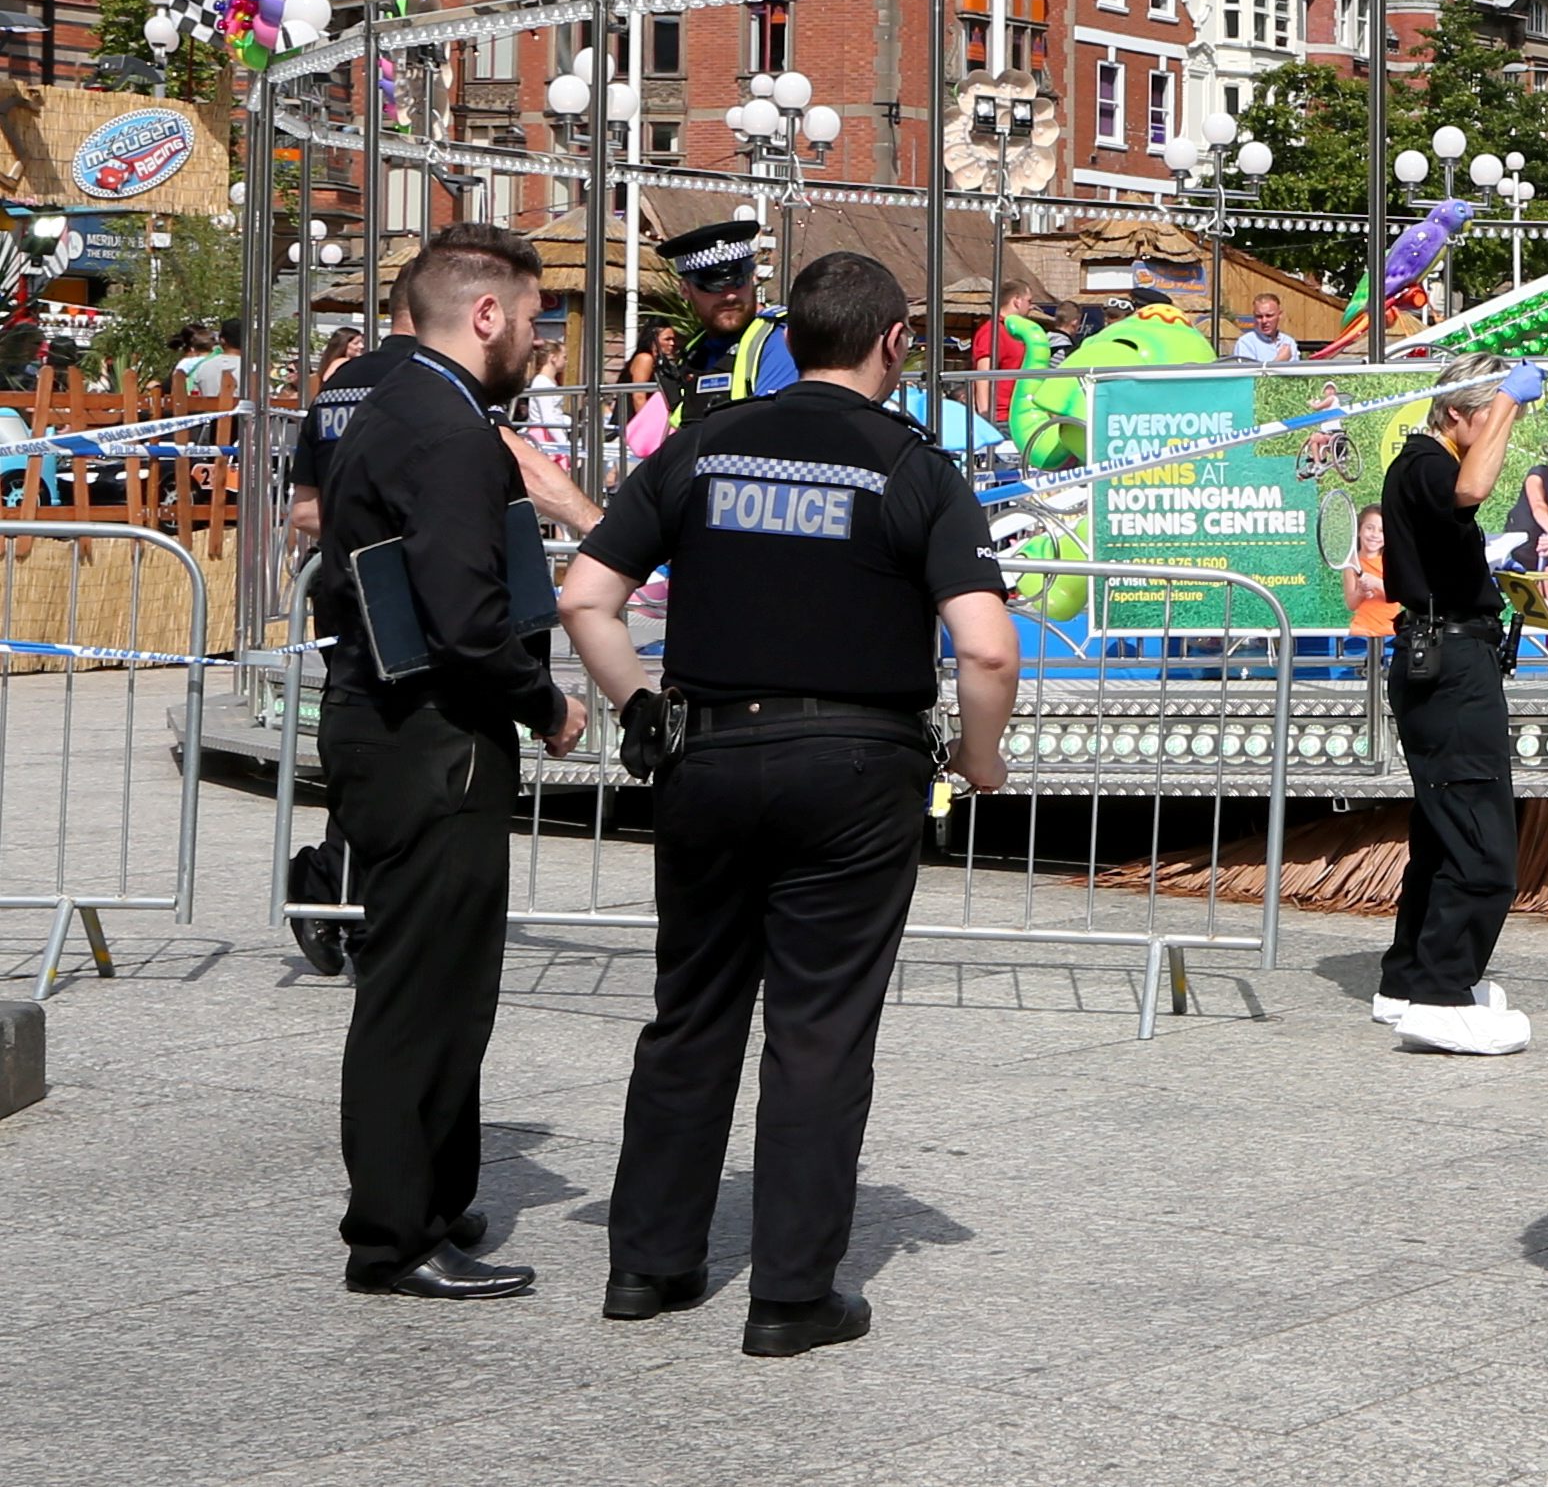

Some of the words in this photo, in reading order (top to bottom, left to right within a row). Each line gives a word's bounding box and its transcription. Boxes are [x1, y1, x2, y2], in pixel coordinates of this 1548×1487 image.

[321, 406, 355, 437] PO
[1108, 412, 1233, 437] EVERYONE
[1108, 439, 1160, 459] CAN
[1201, 462, 1229, 484] AT
[712, 481, 846, 535] POLICE
[1108, 486, 1282, 511] NOTTINGHAM
[1108, 513, 1198, 536] TENNIS
[1203, 511, 1306, 535] CENTRE!
[1109, 590, 1204, 603] /sportandeisure
[1509, 581, 1547, 620] 2
